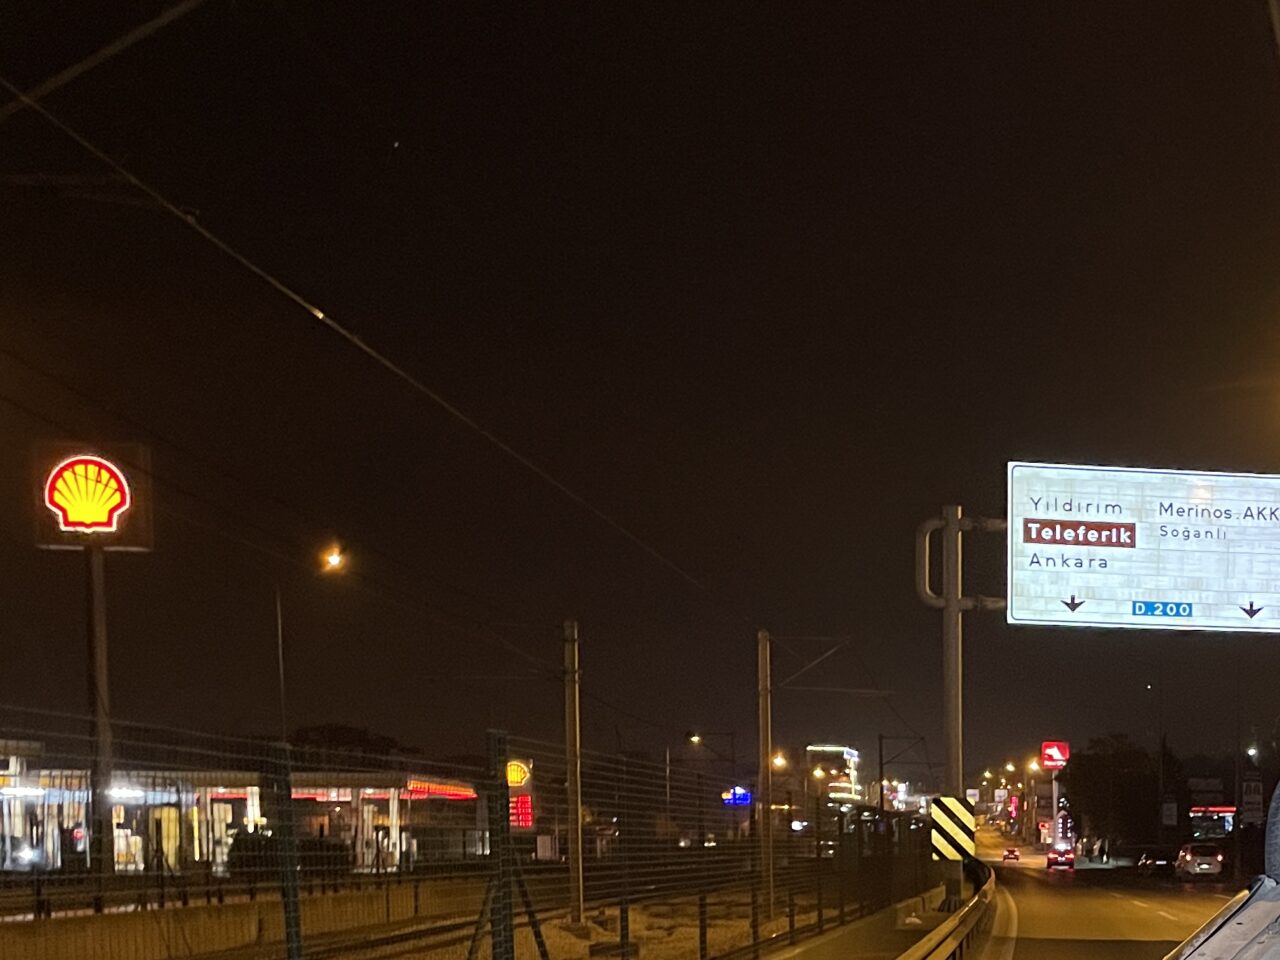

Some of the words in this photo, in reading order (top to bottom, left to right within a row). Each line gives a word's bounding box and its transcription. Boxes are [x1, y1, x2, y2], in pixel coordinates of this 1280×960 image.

[1030, 497, 1122, 514] Yıldırım
[1027, 523, 1132, 543] Teleferik
[1160, 525, 1227, 541] Soğanlı
[1029, 553, 1108, 568] Ankara
